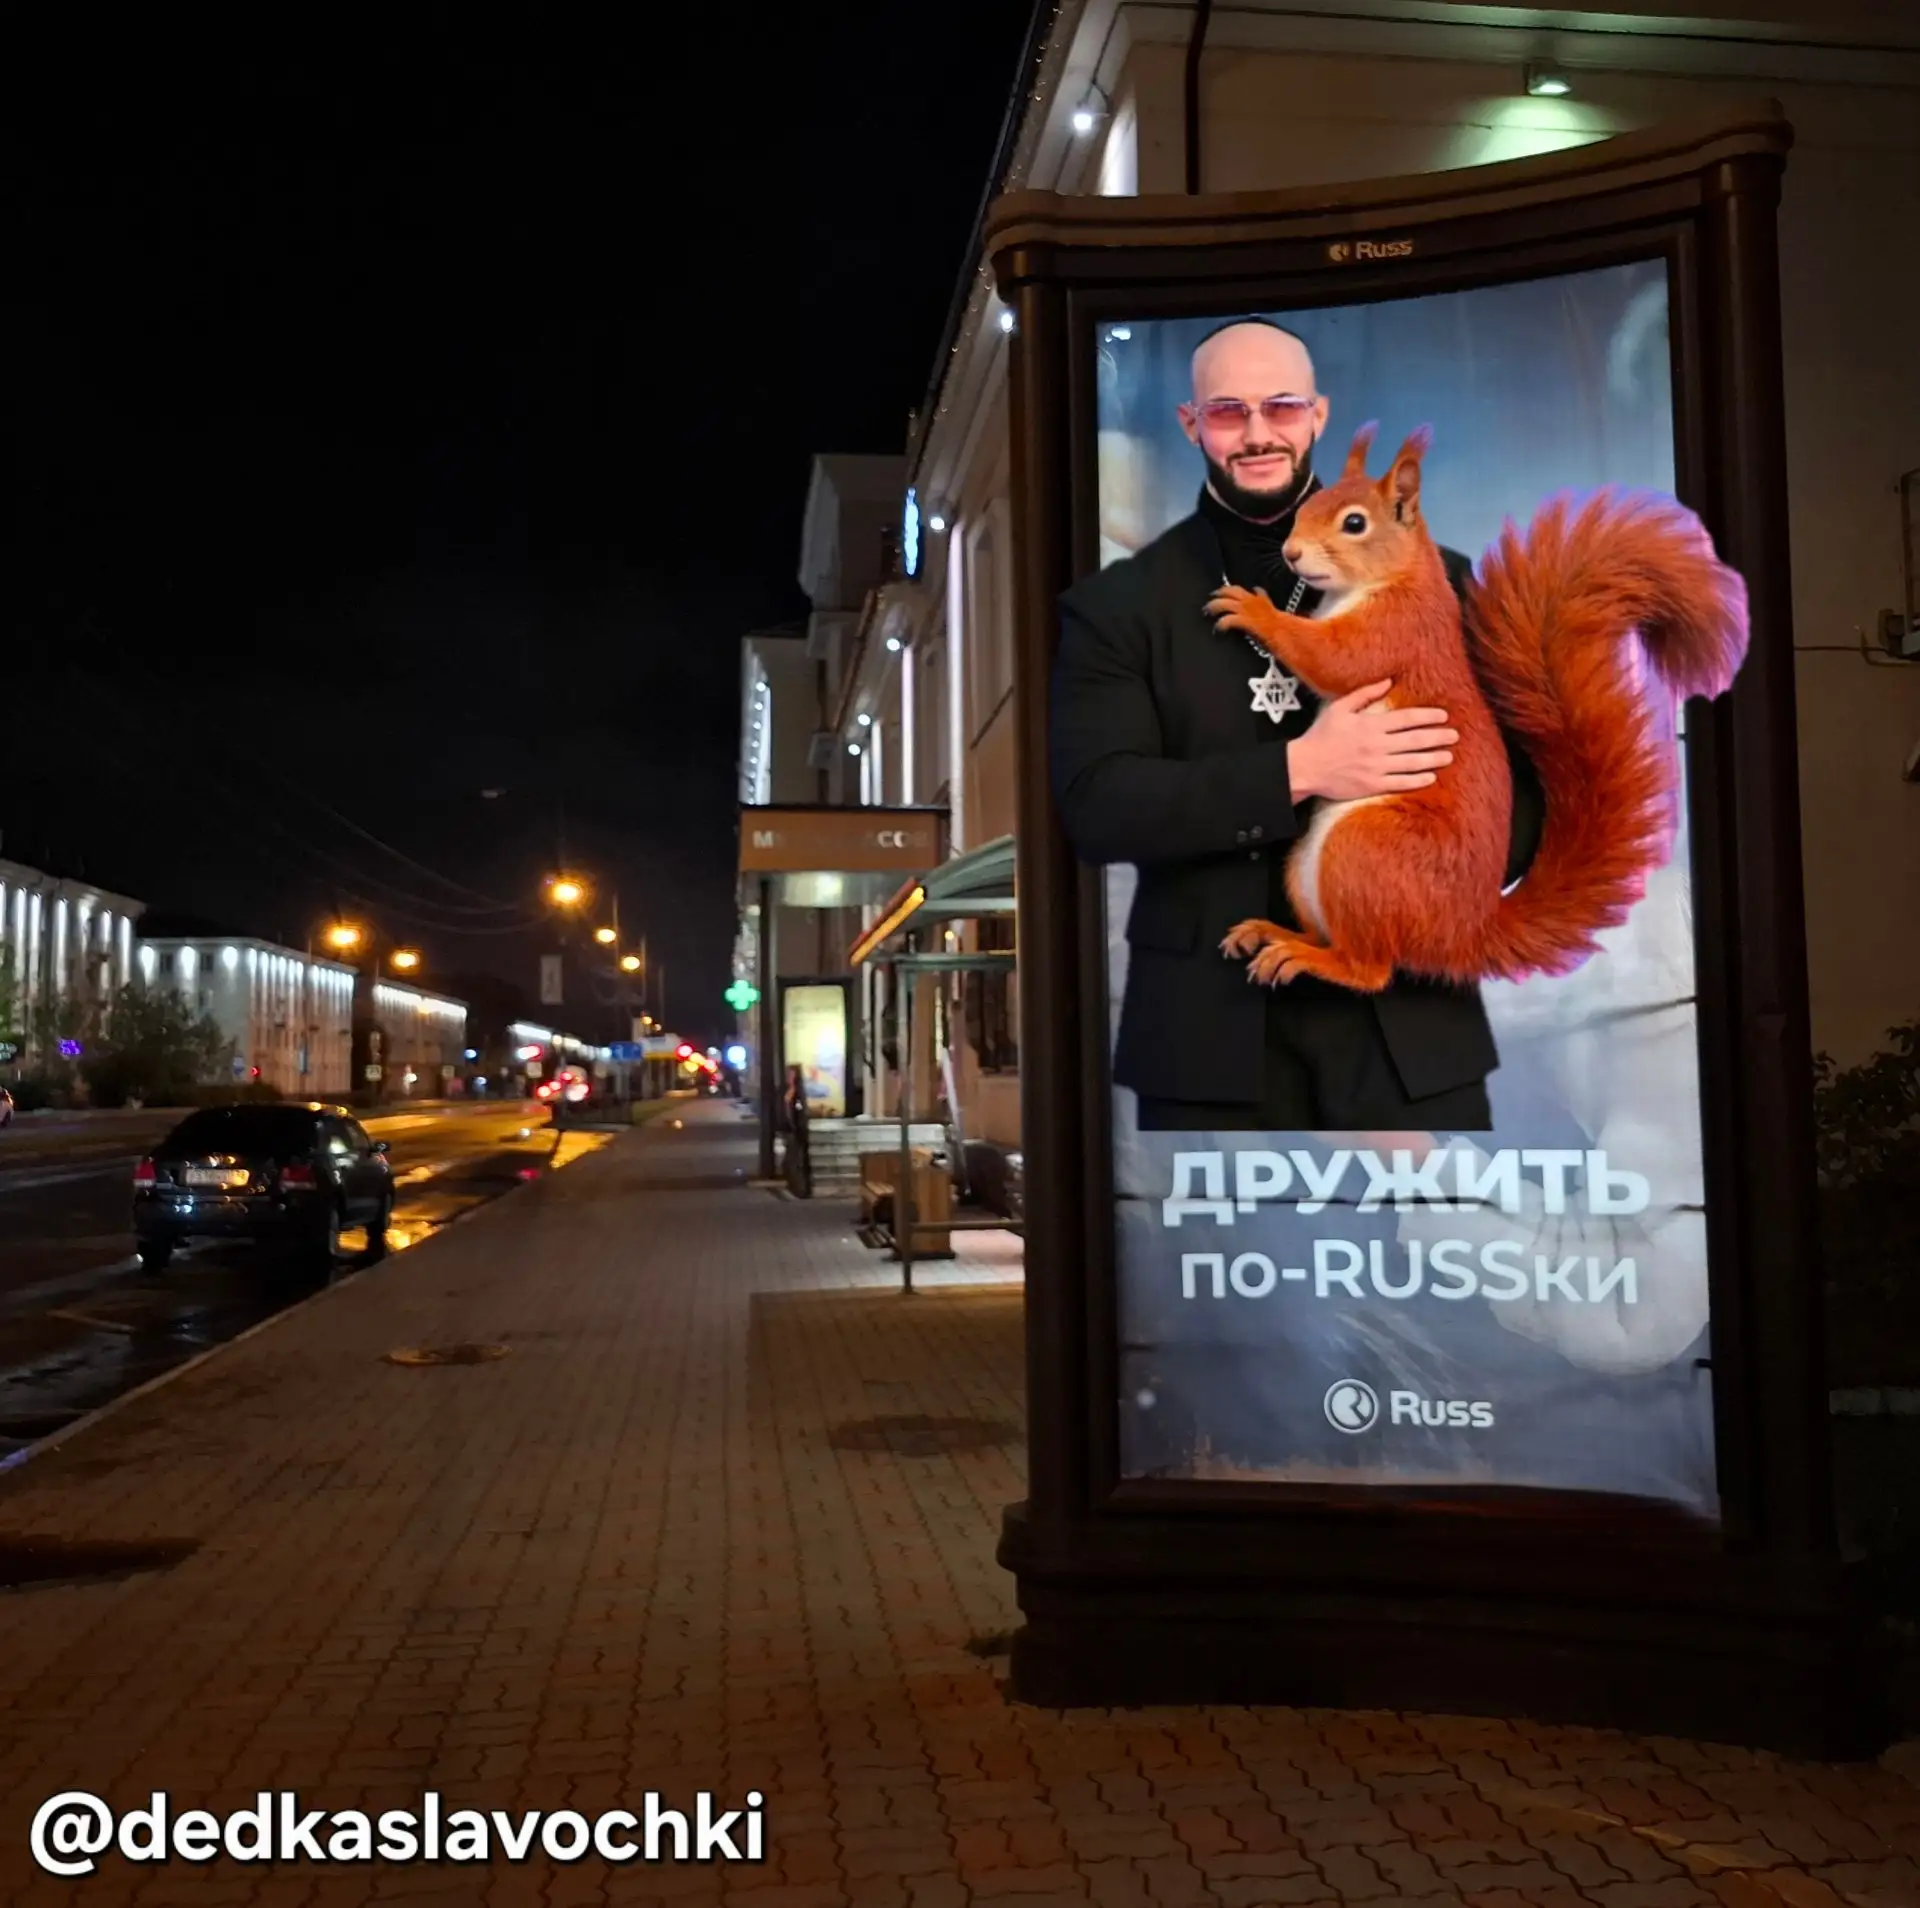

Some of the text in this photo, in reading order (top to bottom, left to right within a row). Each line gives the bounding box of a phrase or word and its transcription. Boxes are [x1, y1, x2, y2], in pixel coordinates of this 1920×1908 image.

[1356, 239, 1413, 259] Russ
[1162, 1148, 1651, 1228] ДРУЖИТЬ
[1180, 1239, 1639, 1305] по-RUSSки
[1390, 1389, 1495, 1429] Russ
